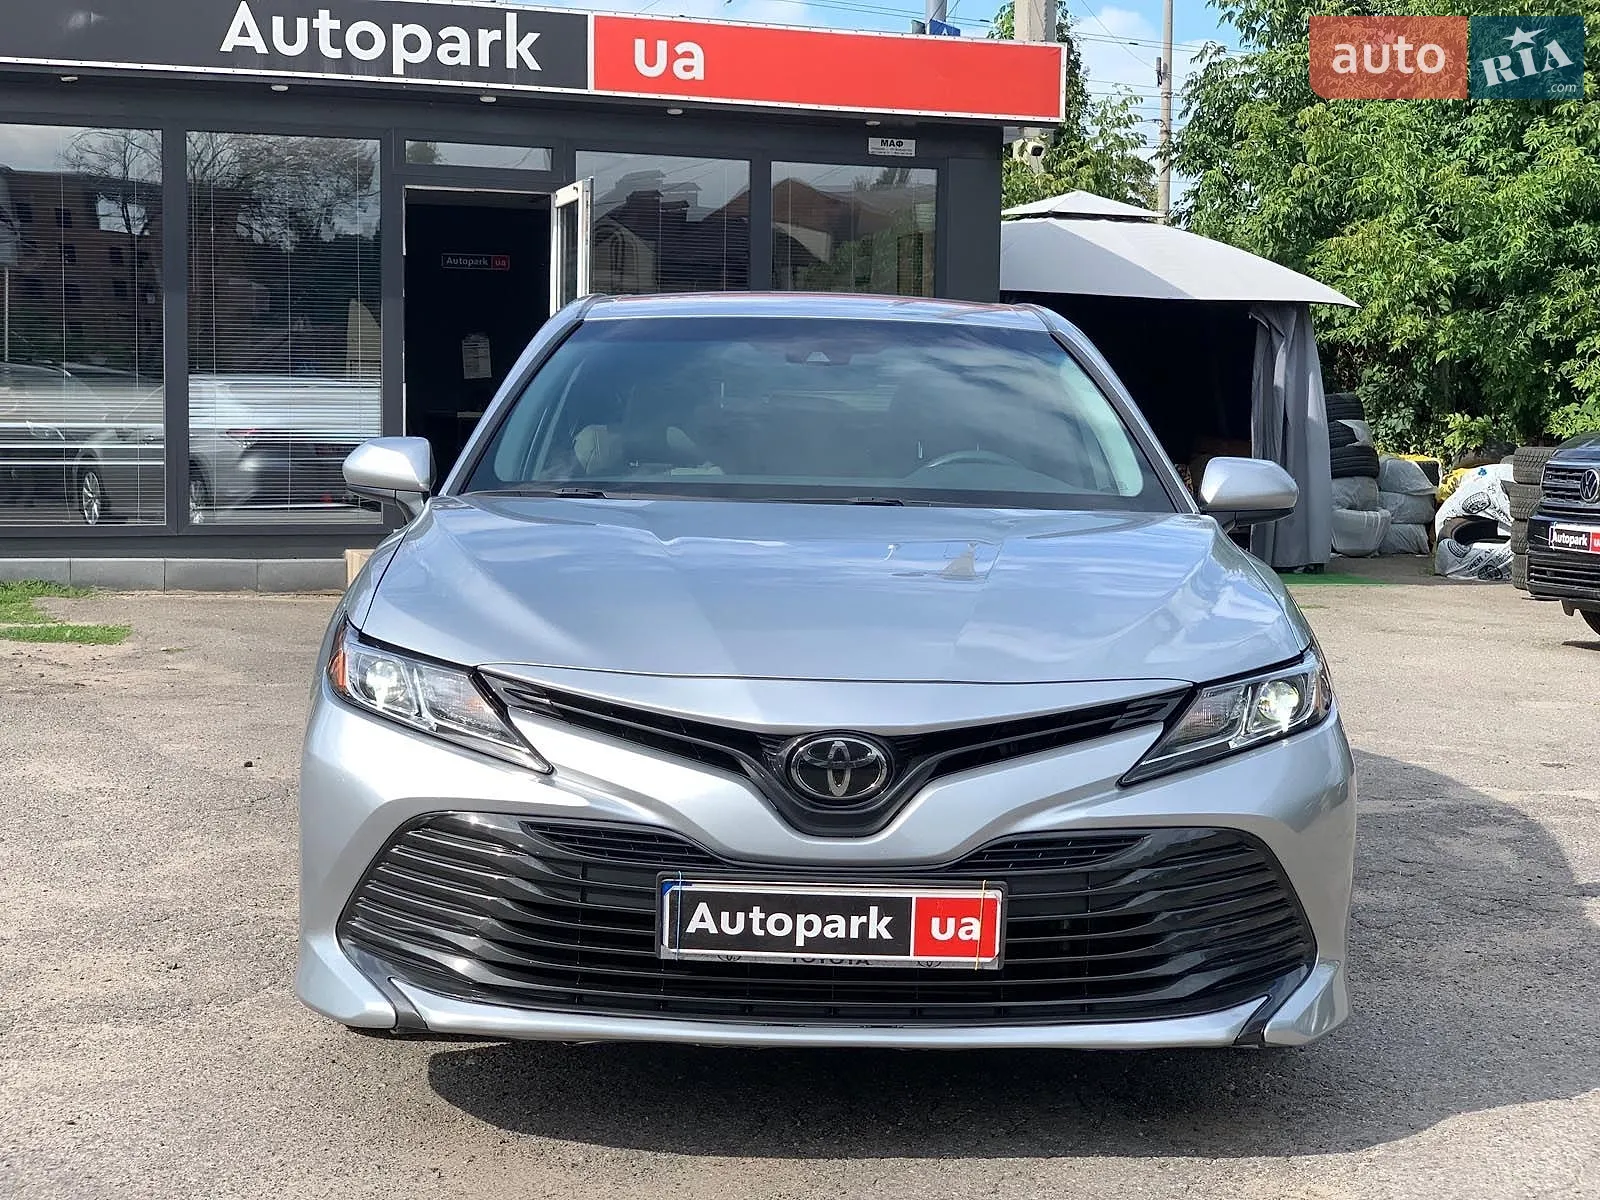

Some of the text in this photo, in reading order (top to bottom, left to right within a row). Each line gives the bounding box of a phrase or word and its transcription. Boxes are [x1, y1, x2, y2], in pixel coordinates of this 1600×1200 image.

[220, 1, 705, 80] Autopark ua
[880, 139, 904, 148] МАФ
[446, 256, 488, 267] Autopark
[1552, 530, 1588, 547] Autopark
[685, 902, 982, 947] Autopark ua
